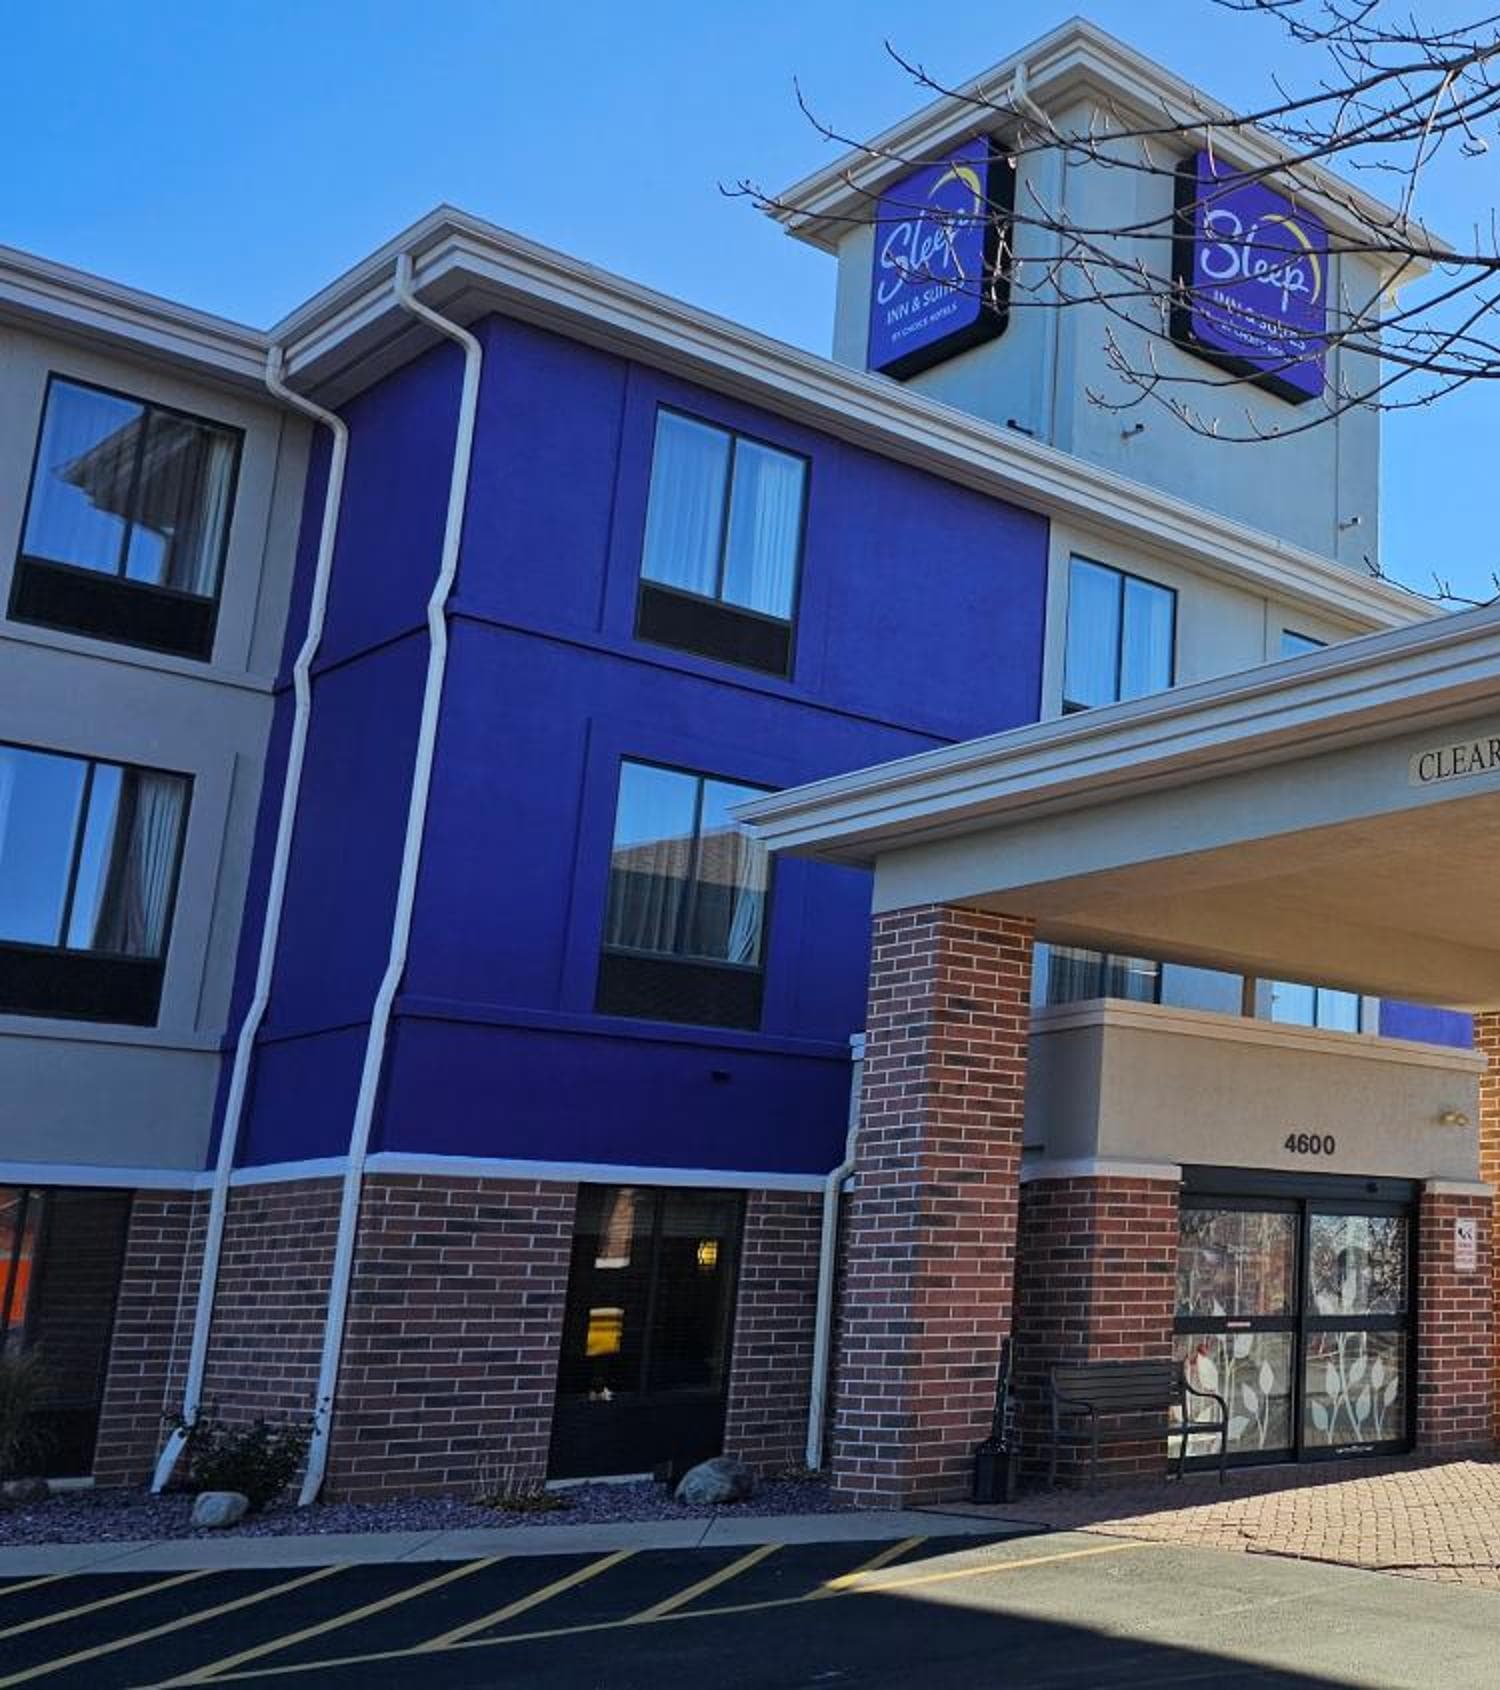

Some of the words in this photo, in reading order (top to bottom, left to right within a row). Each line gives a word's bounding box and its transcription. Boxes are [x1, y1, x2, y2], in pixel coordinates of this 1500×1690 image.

[1201, 209, 1309, 312] Sleep
[887, 301, 910, 325] INN
[911, 296, 921, 313] &
[1284, 1133, 1336, 1155] 4600
